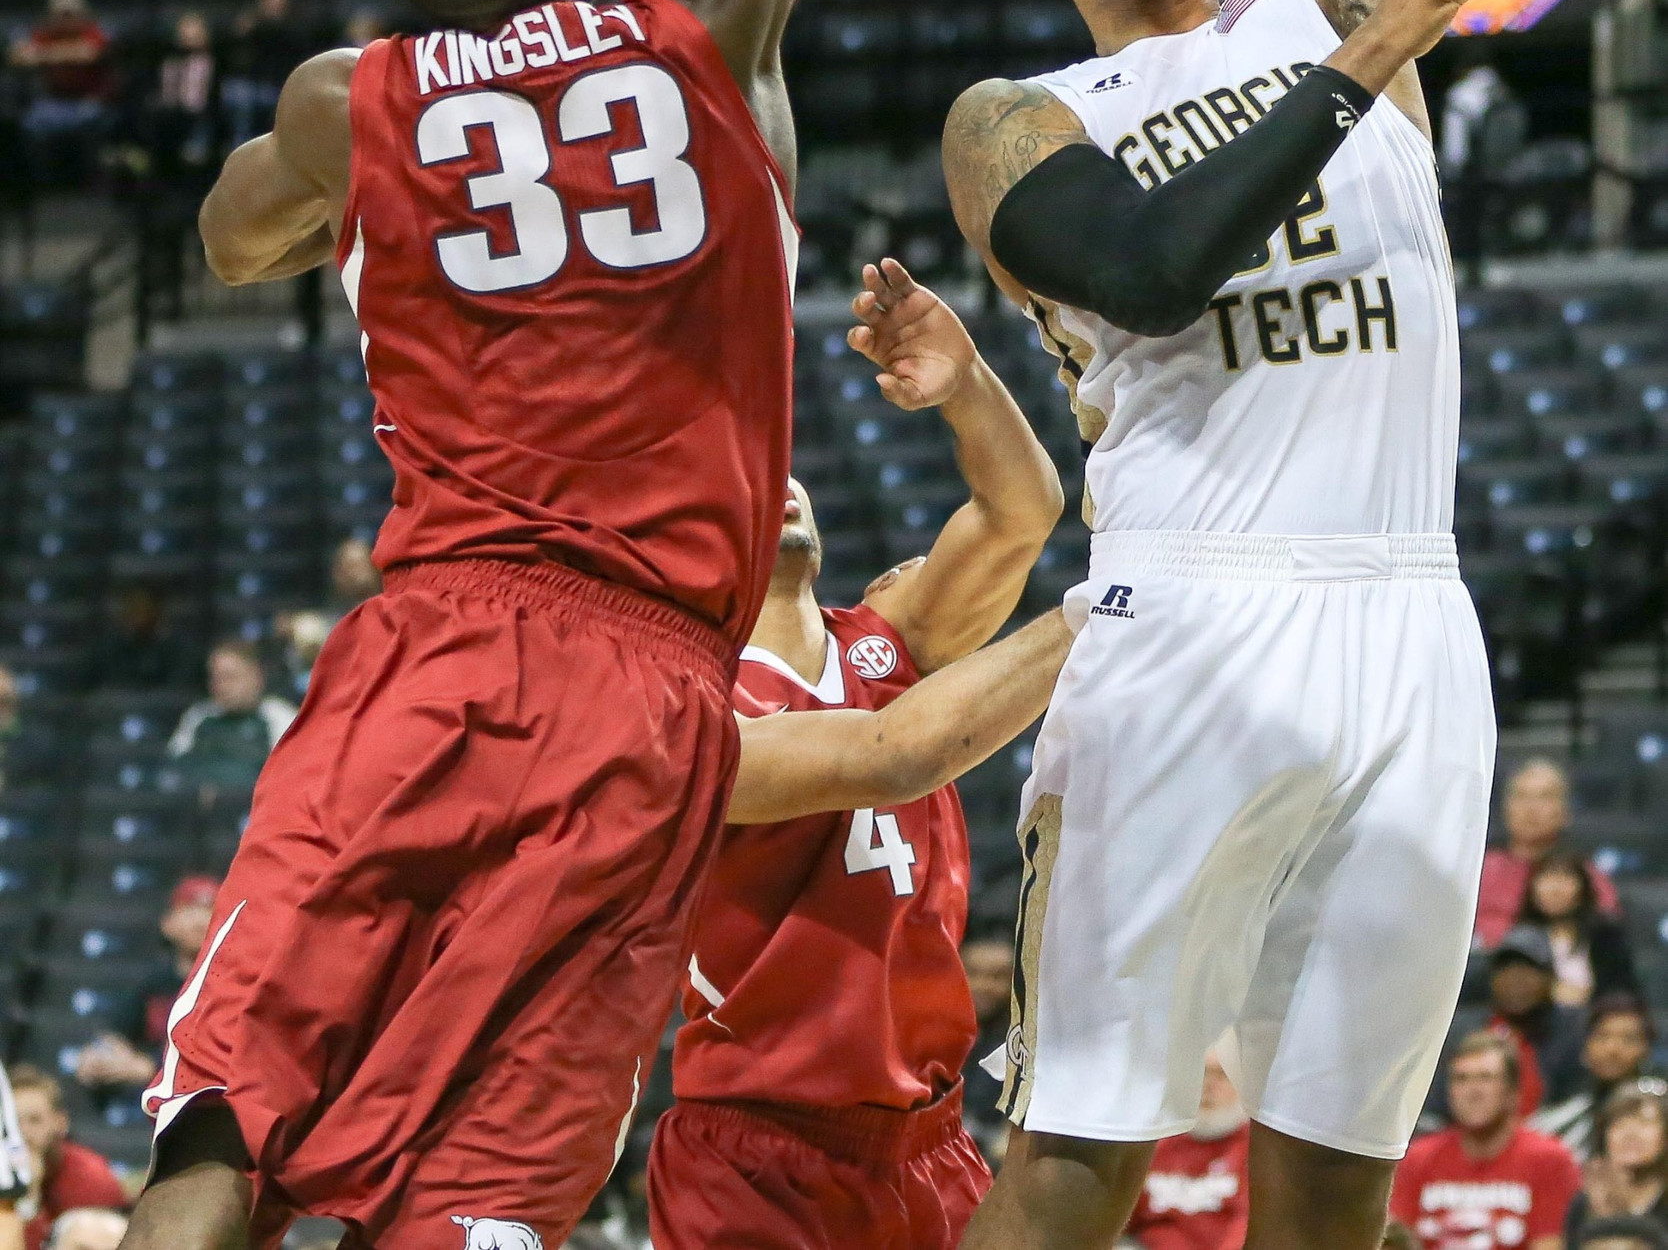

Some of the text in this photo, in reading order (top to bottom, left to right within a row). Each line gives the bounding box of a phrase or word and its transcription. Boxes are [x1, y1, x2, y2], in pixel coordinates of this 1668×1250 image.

[414, 0, 646, 96] KINGSLEY
[416, 63, 706, 293] 33
[1206, 275, 1398, 372] TECH
[849, 637, 896, 677] SEC
[1090, 605, 1136, 620] RUSSELL
[844, 807, 917, 896] 4
